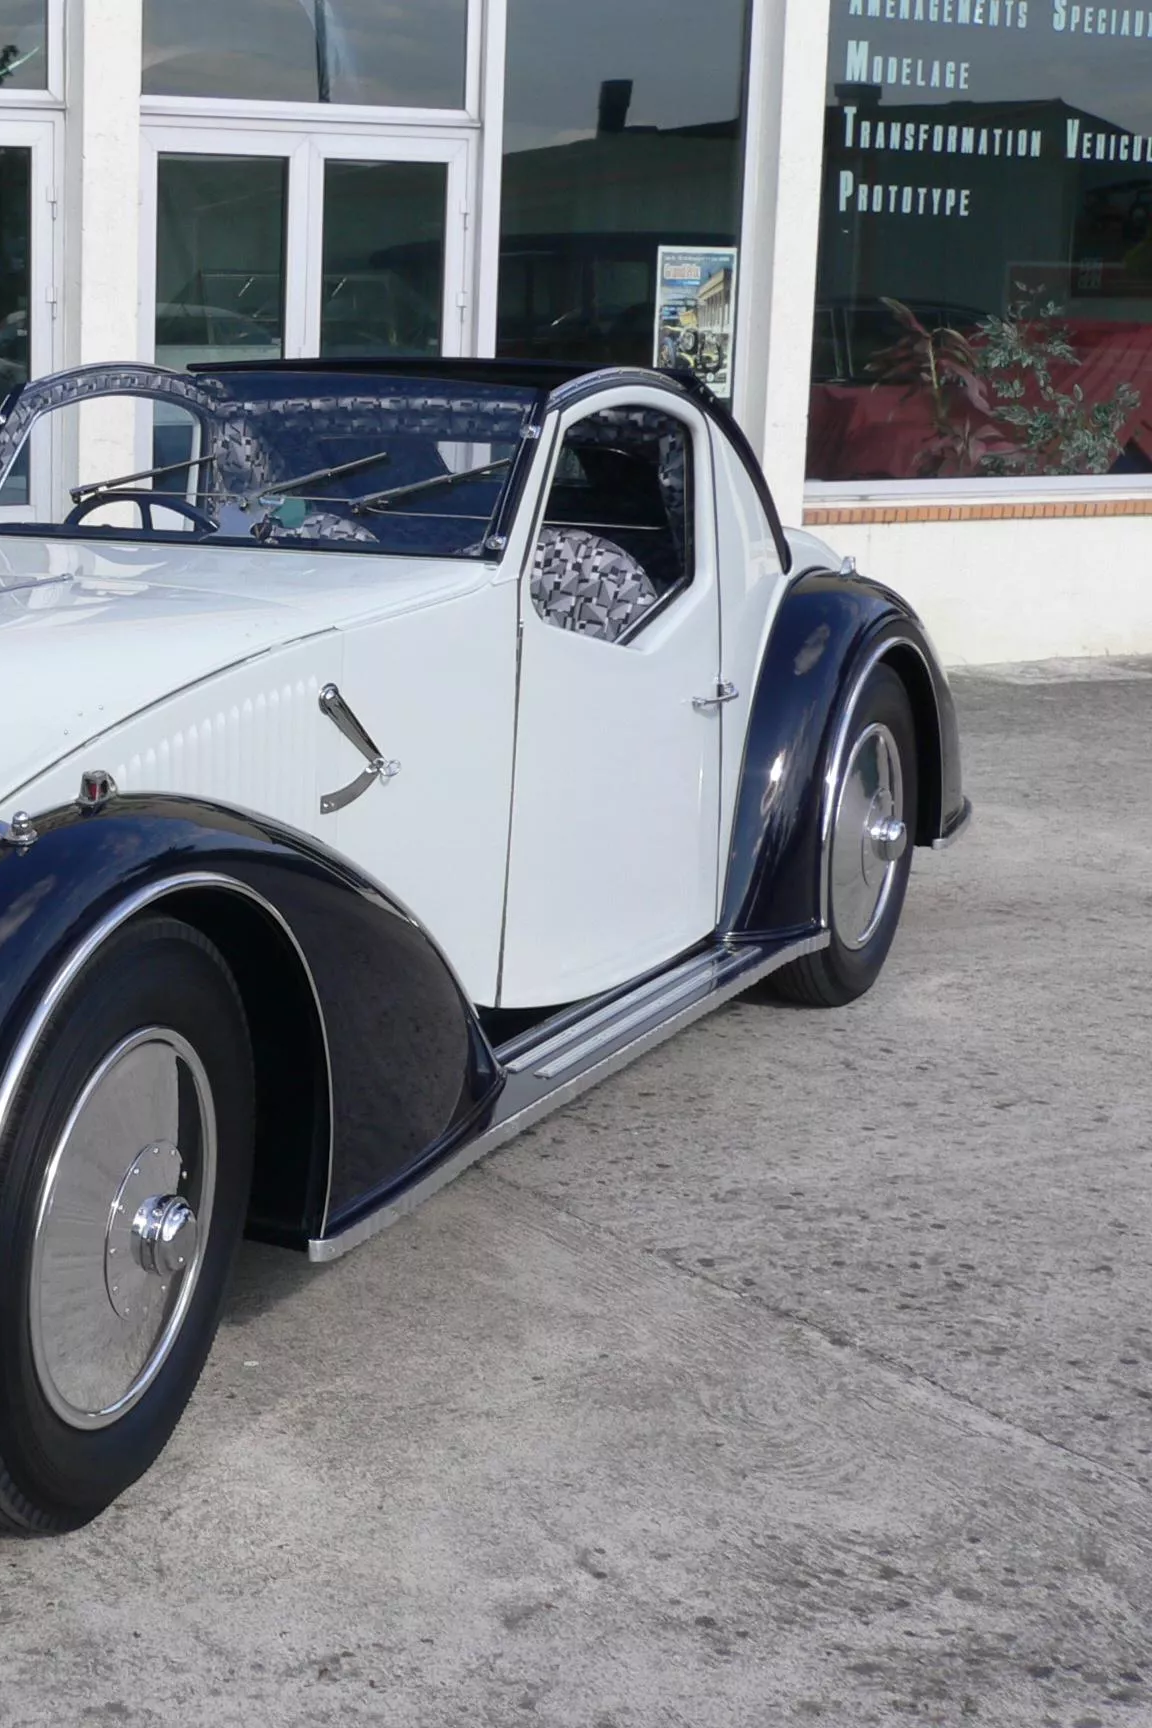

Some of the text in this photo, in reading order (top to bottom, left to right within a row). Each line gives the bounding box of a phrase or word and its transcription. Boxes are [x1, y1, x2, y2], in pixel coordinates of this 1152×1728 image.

[846, 40, 969, 89] MODELAGE
[844, 106, 1041, 157] TRANSFORMATION
[839, 170, 970, 216] PROTOTYPE
